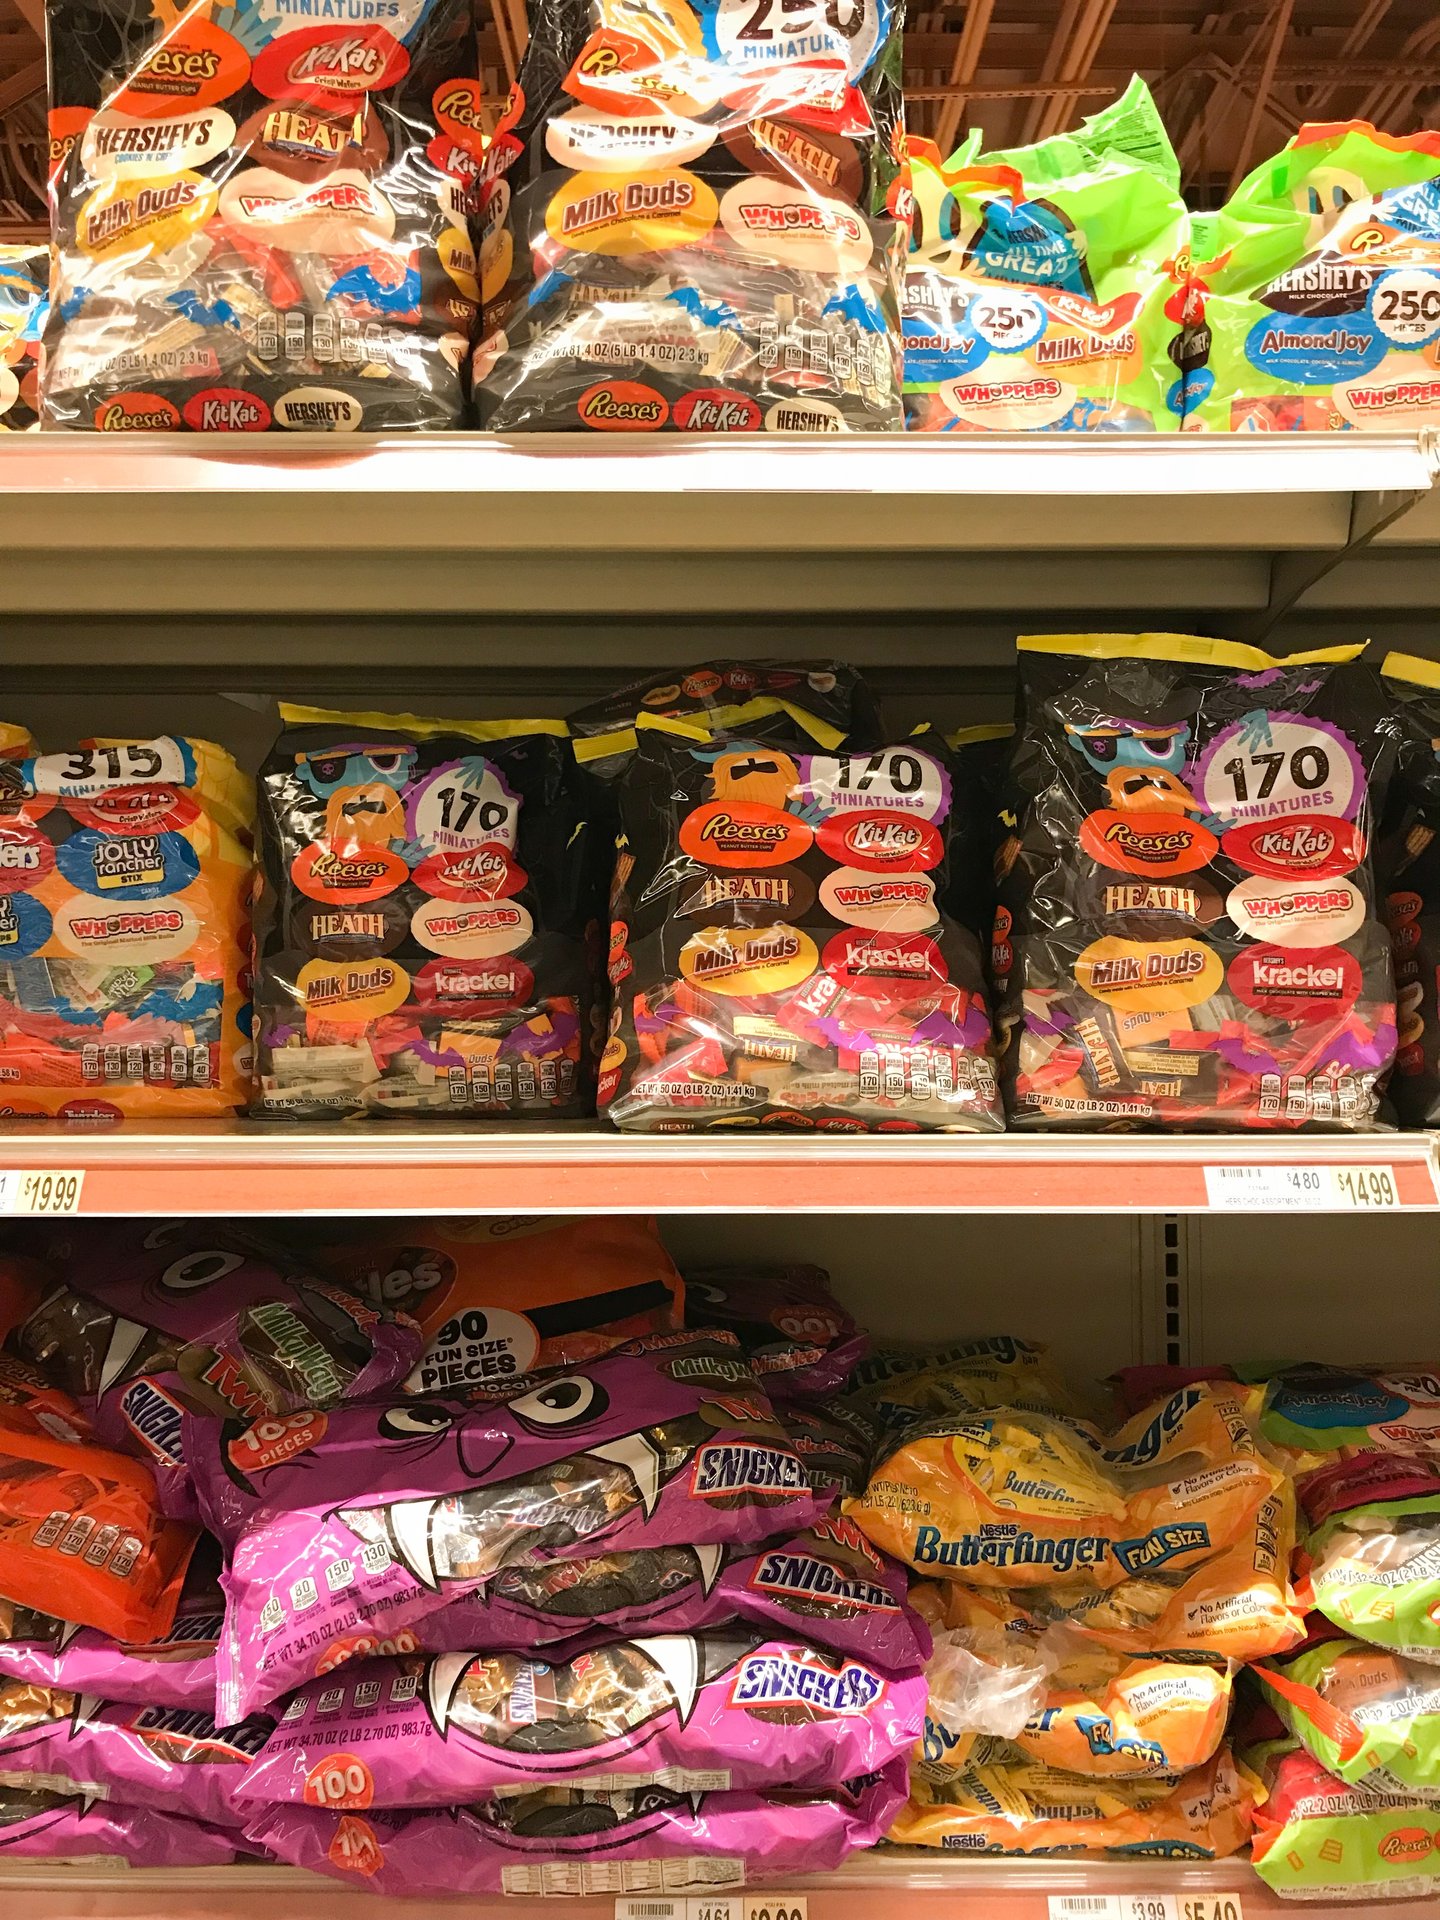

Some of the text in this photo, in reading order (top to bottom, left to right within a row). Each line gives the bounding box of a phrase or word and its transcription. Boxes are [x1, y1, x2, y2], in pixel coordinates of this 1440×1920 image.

[303, 39, 379, 73] KitKat
[750, 117, 841, 187] HEATH
[136, 179, 200, 220] Duds
[562, 178, 693, 233] Milk Duds
[260, 337, 276, 348] 170
[287, 337, 303, 347] 150
[314, 338, 331, 349] 130
[594, 343, 608, 357] OZ
[610, 343, 620, 360] (5
[624, 344, 636, 358] LB
[640, 345, 655, 359] 1.4
[659, 344, 676, 362] OZ)
[679, 346, 695, 361] 2.3
[698, 348, 709, 364] kg
[1036, 336, 1084, 364] Milk
[180, 353, 195, 365] 2.3
[199, 351, 209, 366] kg
[836, 356, 850, 366] 130
[953, 378, 1062, 405] WHOPPERS
[104, 405, 174, 431] Reese's
[203, 400, 260, 431] KitKat
[284, 401, 352, 421] HERSHEY'S
[584, 391, 661, 422] Reese's
[688, 396, 749, 431] KitKat
[60, 745, 162, 781] 315
[838, 753, 923, 793] 170
[1223, 745, 1330, 802] 170
[436, 787, 509, 833] 170
[830, 791, 925, 809] MINIATURES
[1230, 791, 1334, 819] MINIATURES
[700, 813, 789, 842] Reese's
[852, 820, 920, 850] KitKat
[1103, 822, 1194, 852] Reese's
[94, 836, 159, 864] JOLLY
[432, 828, 510, 851] MINIATURES
[1260, 827, 1331, 858] KitKat
[98, 853, 165, 876] rancher
[309, 850, 389, 879] Reese's
[443, 850, 505, 877] KitKat
[120, 873, 143, 884] STIX
[703, 878, 790, 906] HEATH
[833, 881, 931, 906] WHOPPERS
[1105, 885, 1196, 919] HEATH
[1242, 889, 1353, 919] WHOPPERS
[68, 911, 184, 939] WHOPPERS
[311, 913, 385, 941] HEATH
[424, 908, 521, 937] WHOPPERS
[693, 936, 799, 973] Milk Duds
[765, 959, 790, 970] Caramel
[846, 943, 930, 971] krackel
[1090, 948, 1205, 988] Milk Duds
[1252, 960, 1344, 989] krackel
[306, 966, 394, 1002] Milk Duds
[434, 971, 515, 993] krackel
[1133, 976, 1194, 989] Chocolate Caramel
[83, 1062, 98, 1071] 170
[106, 1062, 120, 1071] 130
[467, 1053, 494, 1065] Duds
[452, 1085, 466, 1095] 170
[475, 1084, 489, 1094] 150
[497, 1083, 511, 1093] 140
[518, 1082, 533, 1092] 130
[542, 1080, 556, 1091] 120
[660, 1084, 671, 1094] 50
[671, 1084, 683, 1095] OZ
[683, 1084, 692, 1096] (3
[692, 1084, 704, 1095] LB
[704, 1085, 710, 1095] 2
[710, 1084, 726, 1097] OZ)
[742, 1086, 756, 1098] kg
[862, 1076, 877, 1086] 170
[888, 1076, 903, 1087] 150
[1026, 1093, 1152, 1116] NET WT 50 OZ (3 LB 2 OZ) 1.41 kg
[1262, 1099, 1278, 1109] 170
[1289, 1100, 1305, 1110] 150
[436, 1310, 488, 1346] 90
[425, 1348, 463, 1366] FUN
[420, 1353, 517, 1389] PIECES
[239, 1413, 315, 1451] 100
[259, 1428, 314, 1466] PIECES
[1184, 1475, 1198, 1488] No
[1185, 1474, 1225, 1495] Flavors or
[67, 1533, 82, 1546] 170
[91, 1544, 107, 1557] 170
[913, 1524, 1110, 1573] Butterfinger
[116, 1555, 131, 1568] 170
[364, 1543, 387, 1560] 130
[1126, 1536, 1159, 1569] FUN
[327, 1558, 350, 1577] 150
[1199, 1593, 1252, 1614] No Artificial
[278, 1586, 427, 1667] WT 34.70 OZ (2 LB 2.70 OZ) 983.7g
[1200, 1609, 1241, 1625] Flavors or
[356, 1681, 380, 1696] 150
[393, 1676, 416, 1691] 130
[738, 1659, 883, 1710] SNICKERS
[1360, 1670, 1388, 1687] Duds
[323, 1688, 341, 1701] 80
[1132, 1691, 1145, 1702] No
[282, 1737, 298, 1749] WT
[298, 1732, 323, 1747] 34.70
[323, 1732, 337, 1746] OZ
[339, 1730, 349, 1747] (2
[350, 1729, 362, 1743] LB
[363, 1727, 383, 1742] 2.70
[383, 1724, 400, 1742] OZ)
[400, 1721, 432, 1738] 983.7g
[308, 1765, 366, 1804] 100
[1302, 1795, 1373, 1814] 32.2 OZ (2 LB
[1383, 1837, 1433, 1857] Reese's
